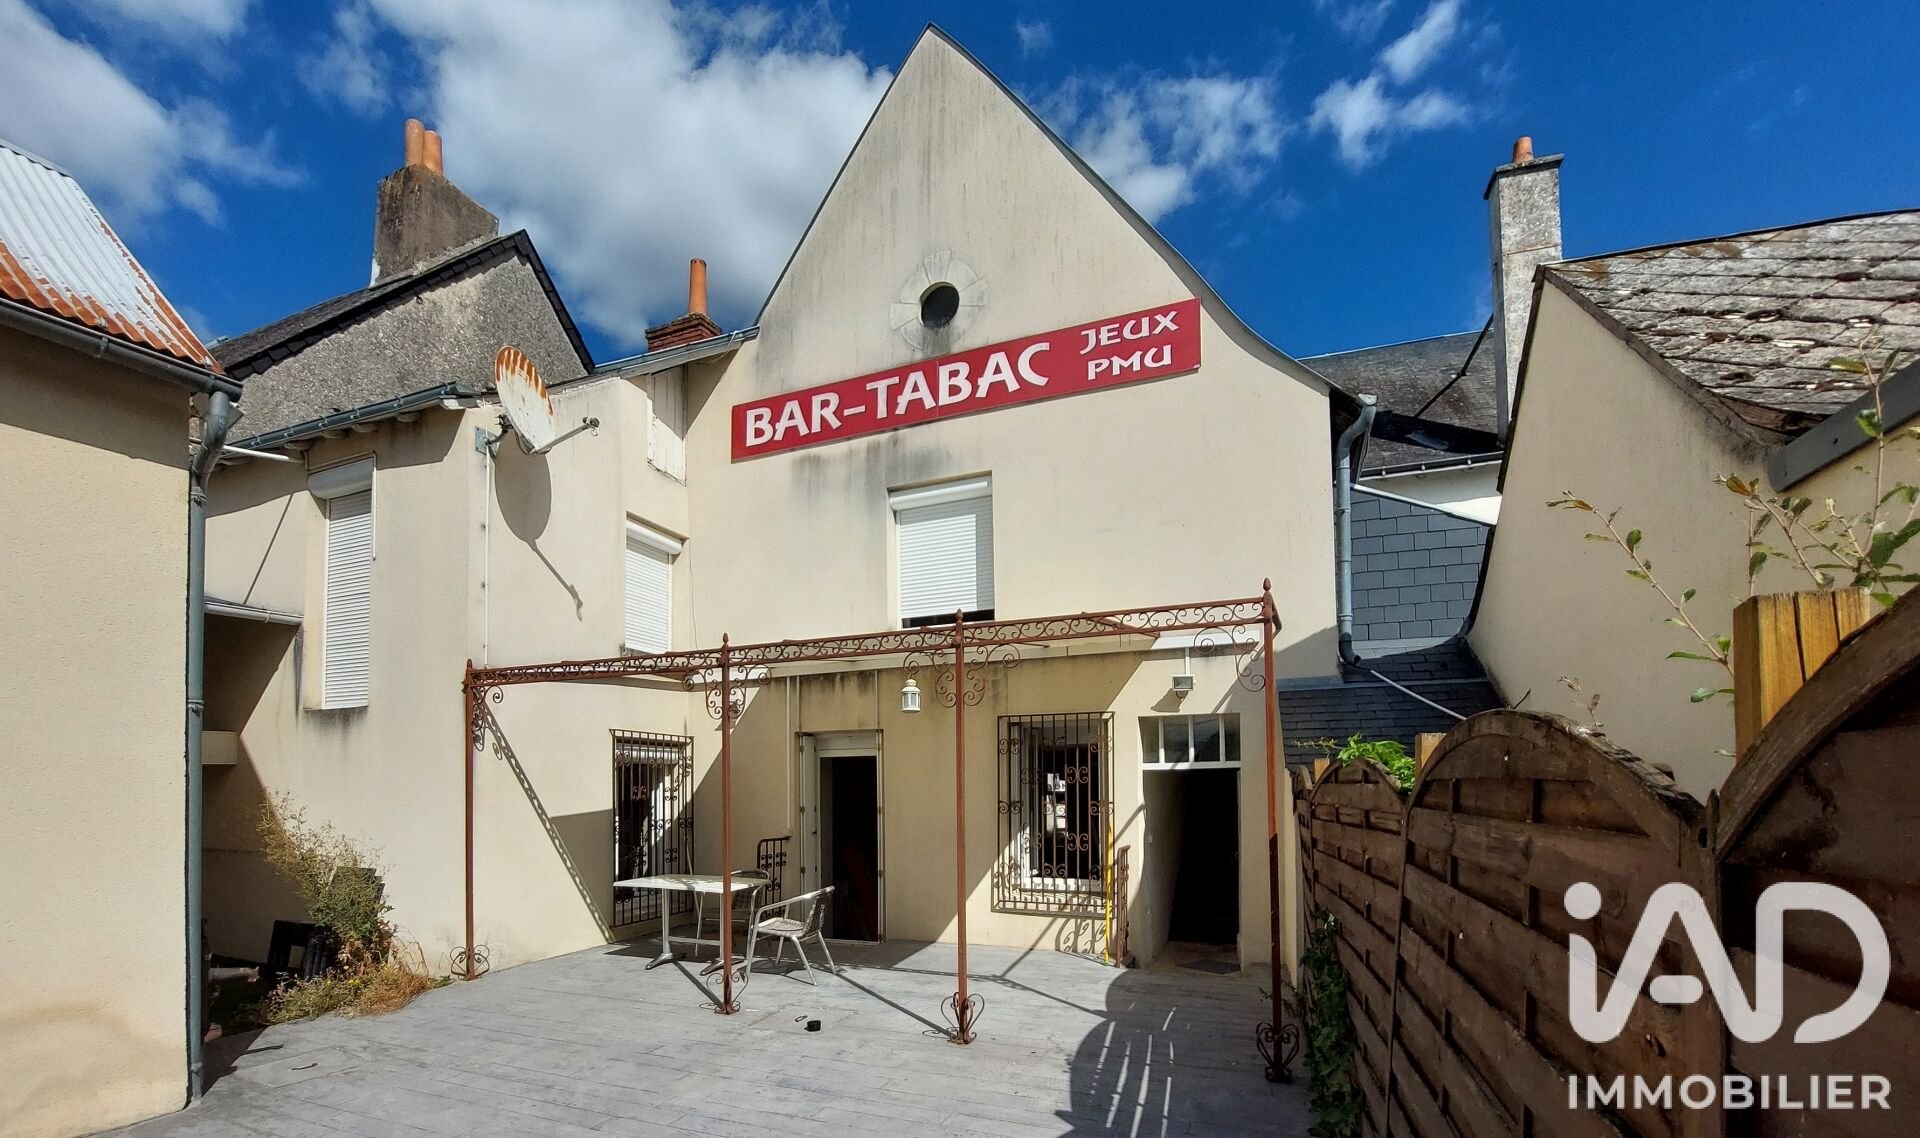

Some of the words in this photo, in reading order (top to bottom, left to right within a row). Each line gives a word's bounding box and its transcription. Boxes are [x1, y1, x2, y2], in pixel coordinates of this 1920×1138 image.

[1079, 311, 1179, 355] JEUX
[1087, 344, 1172, 381] PMU
[745, 342, 1050, 447] BAR-TABAC
